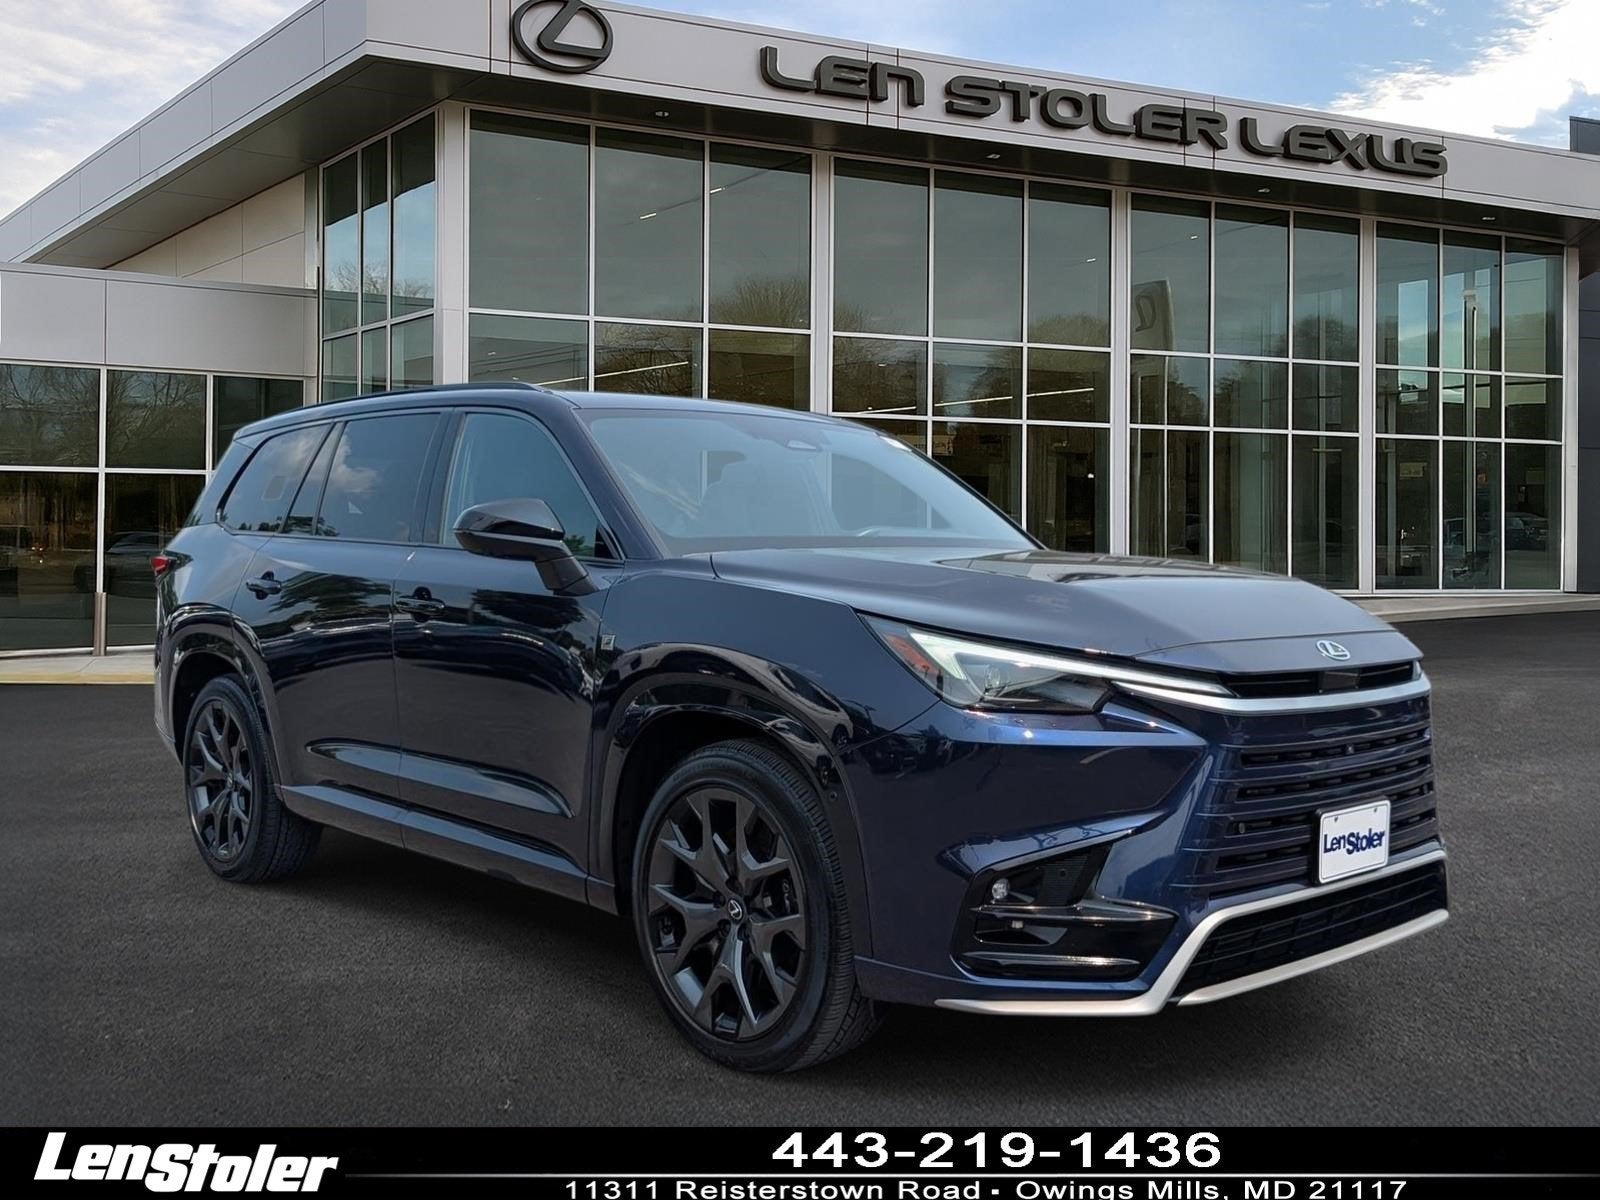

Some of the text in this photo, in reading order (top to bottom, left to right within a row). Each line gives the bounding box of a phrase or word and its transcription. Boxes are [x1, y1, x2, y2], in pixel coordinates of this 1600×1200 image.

[760, 45, 1448, 177] LEN STOLER LEXUS
[1323, 828, 1385, 855] LenStoler
